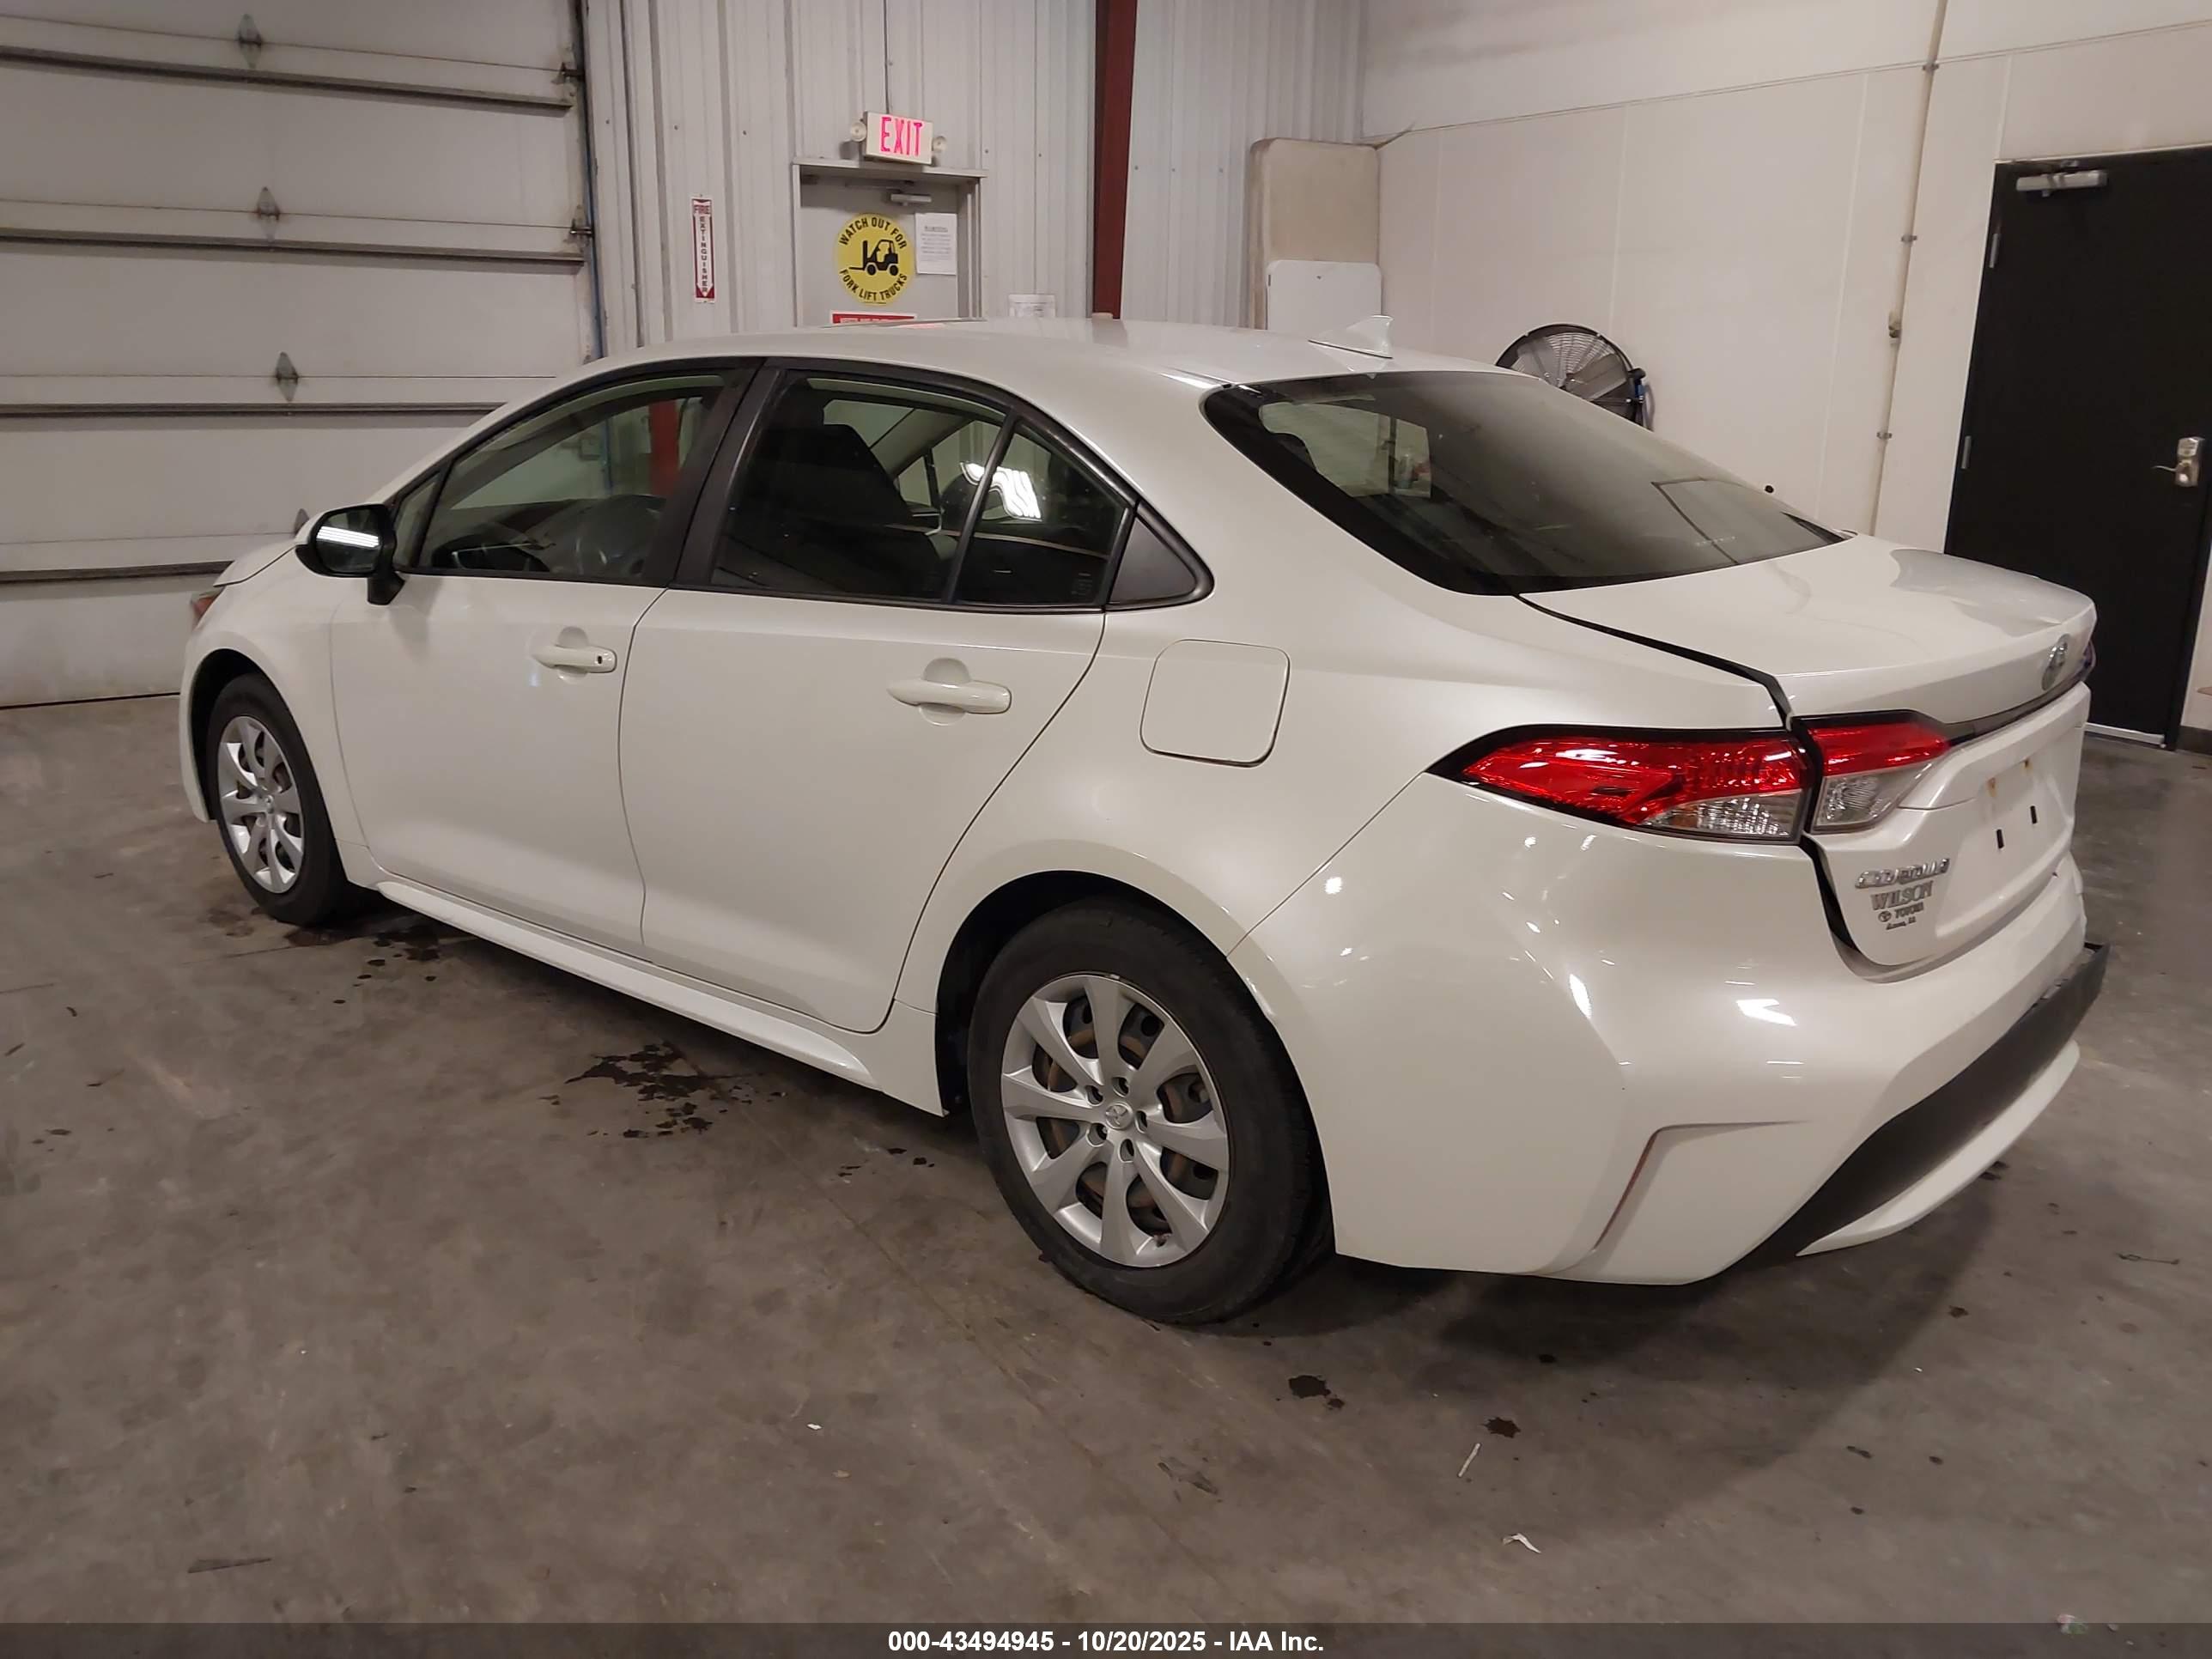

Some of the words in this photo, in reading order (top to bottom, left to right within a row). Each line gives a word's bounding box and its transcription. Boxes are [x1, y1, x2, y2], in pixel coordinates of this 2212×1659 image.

[880, 116, 923, 156] EXIT
[838, 217, 869, 246] WATCH
[871, 216, 890, 230] OUT
[890, 227, 908, 249] FOR
[699, 216, 708, 293] EXTINGUISHER
[839, 268, 860, 293] FORK
[859, 289, 877, 301] LIFT
[879, 273, 908, 301] TRUCKS
[1870, 880, 1934, 911] WILSON
